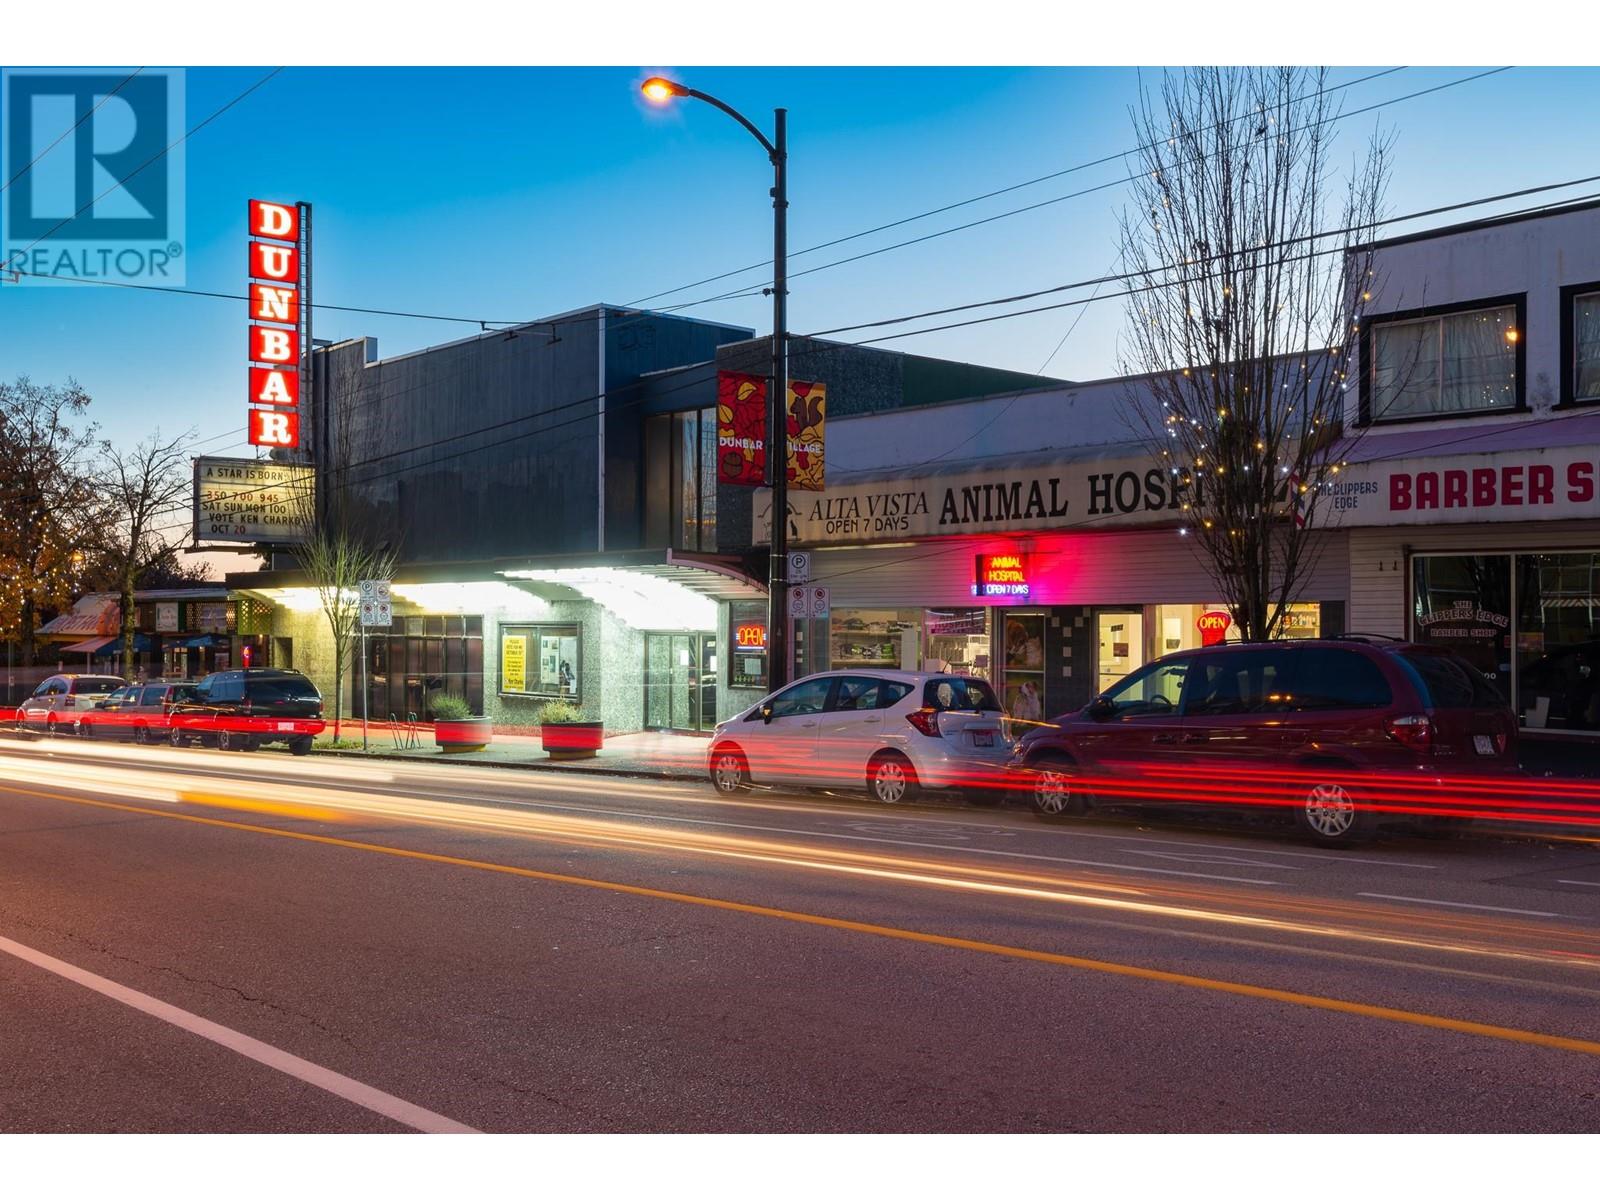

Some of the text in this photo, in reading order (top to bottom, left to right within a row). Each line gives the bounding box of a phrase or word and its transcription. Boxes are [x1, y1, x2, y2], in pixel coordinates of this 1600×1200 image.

[258, 203, 293, 444] DUNBAR
[720, 437, 763, 450] DUNBAR
[786, 440, 821, 454] ILLAGE
[207, 467, 284, 480] A STAR IS BORN
[1333, 481, 1378, 495] CLIPPERS
[1389, 461, 1600, 511] BARBER S
[207, 490, 279, 503] 350 700 945
[808, 495, 861, 522] ALTA
[866, 491, 930, 517] VISTA
[938, 478, 1069, 525] ANIMAL
[1335, 496, 1358, 509] EDGE
[202, 501, 286, 514] SAT SUN MON 100
[209, 513, 234, 523] VOTE
[240, 514, 258, 525] KEN
[826, 516, 909, 534] OPEN 7 DAYS
[211, 524, 246, 536] OCT 20
[991, 557, 1021, 568] ANIMAL
[988, 571, 1025, 582] HOSPITAL
[986, 584, 1006, 594] OPEN
[1011, 584, 1029, 594] DAYS
[1200, 616, 1226, 629] OPEN
[1419, 608, 1509, 628] CLIPPERS EDGE
[738, 627, 764, 646] OPEN
